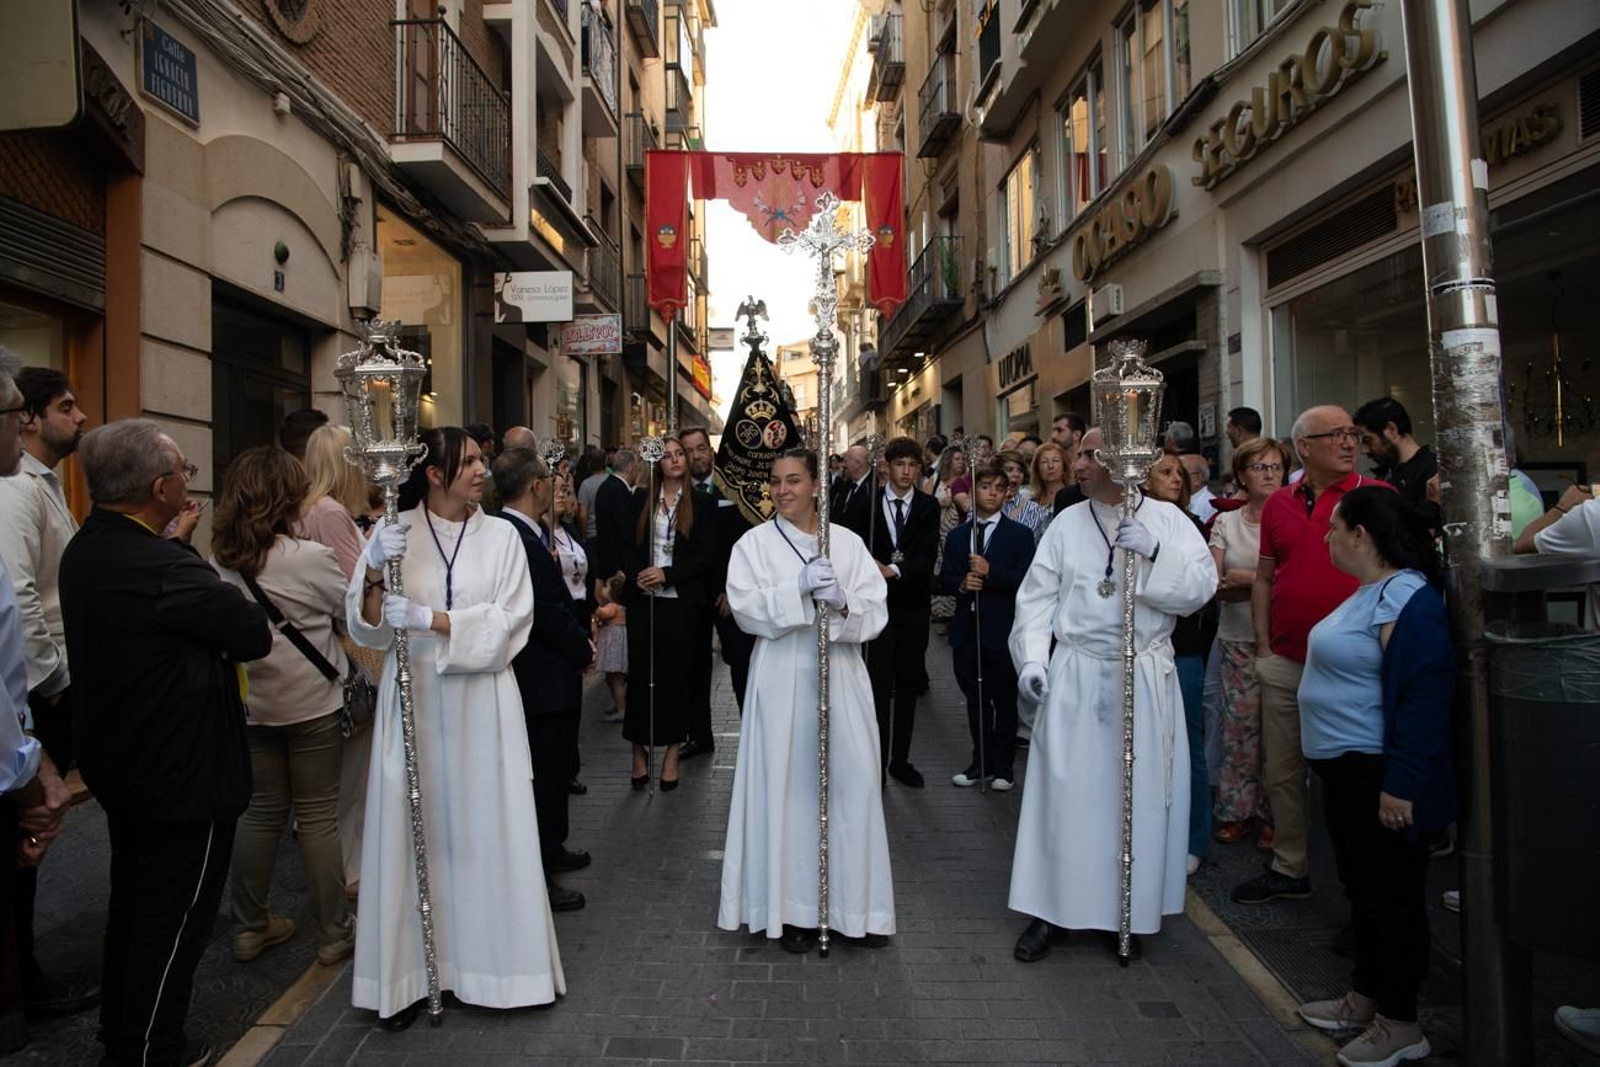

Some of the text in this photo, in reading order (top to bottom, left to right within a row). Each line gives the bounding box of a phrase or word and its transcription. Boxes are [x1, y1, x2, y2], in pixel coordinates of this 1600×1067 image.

[161, 34, 187, 64] Calle
[1191, 0, 1381, 190] SEGUROS
[1073, 164, 1176, 282] OCASO
[511, 284, 569, 296] Vanesa López
[998, 342, 1034, 388] UTOPIA
